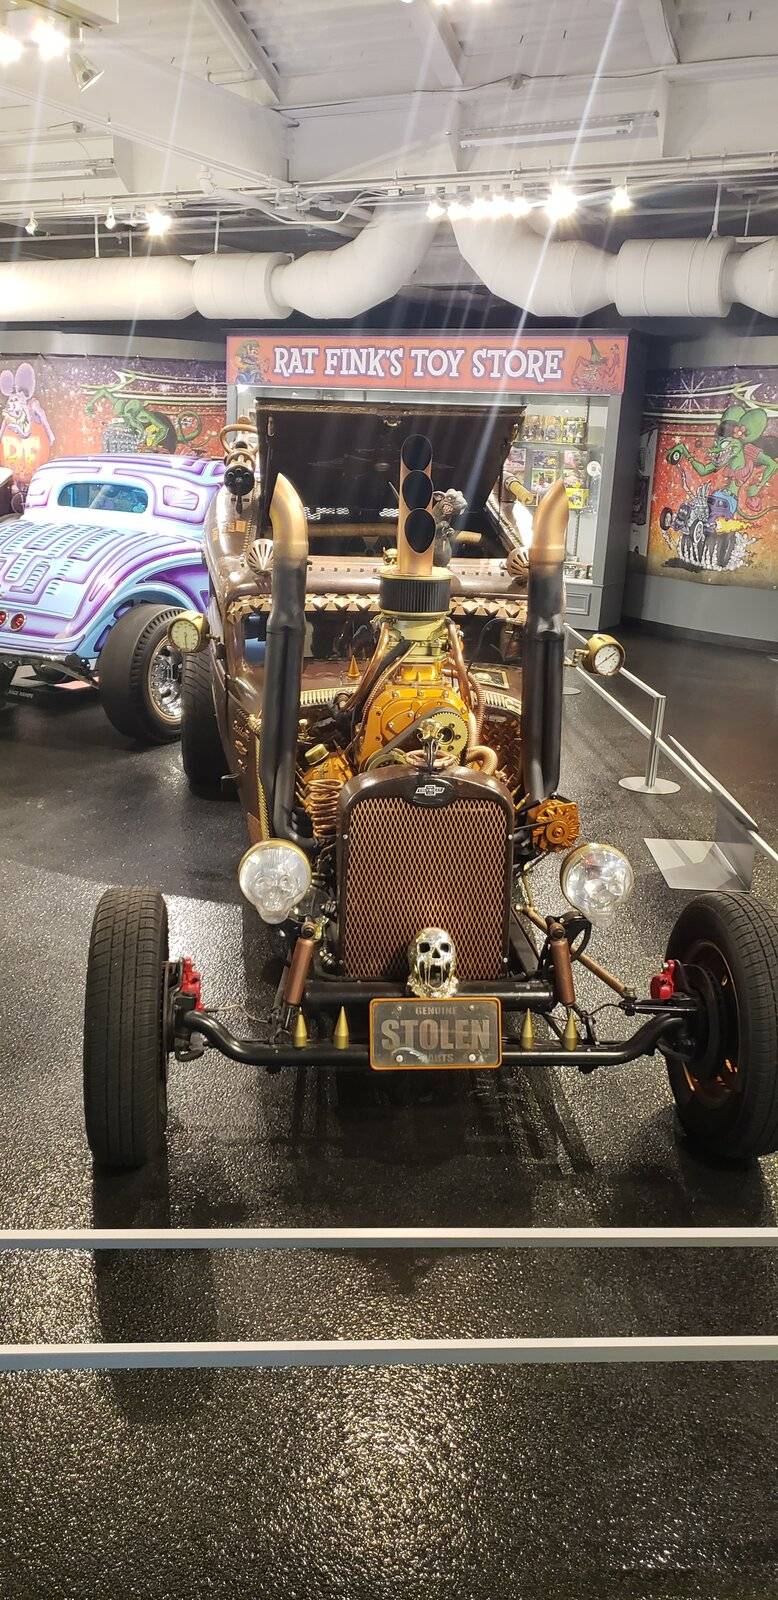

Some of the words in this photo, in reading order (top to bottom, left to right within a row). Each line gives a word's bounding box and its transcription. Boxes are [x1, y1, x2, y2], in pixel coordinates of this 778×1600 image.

[273, 347, 319, 377] RAT
[324, 347, 404, 377] FINK'S
[410, 349, 465, 377] TOY
[472, 348, 564, 383] STORE
[415, 1006, 457, 1015] GENUINE
[381, 1019, 490, 1050] STOLEN
